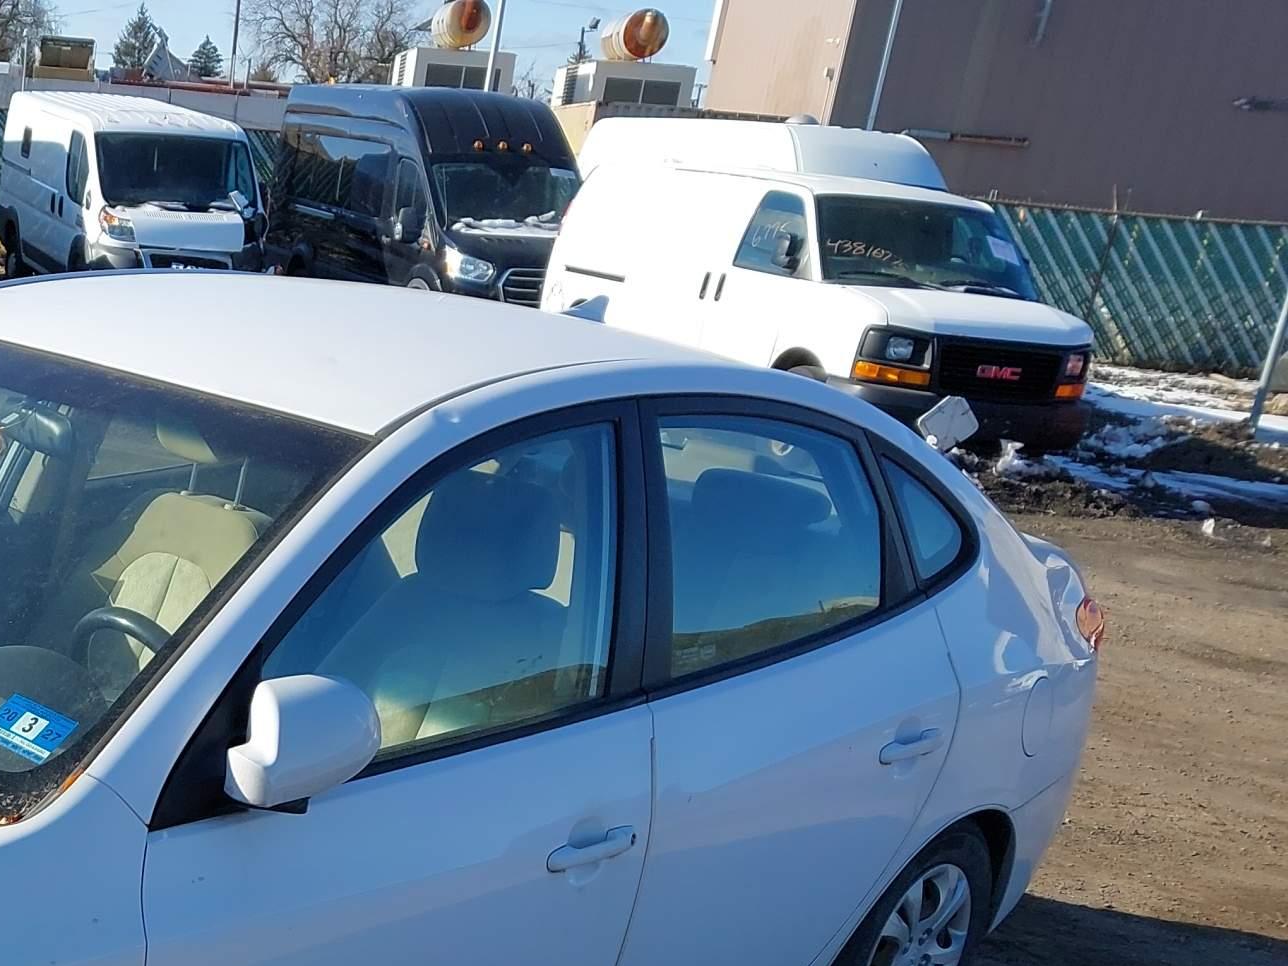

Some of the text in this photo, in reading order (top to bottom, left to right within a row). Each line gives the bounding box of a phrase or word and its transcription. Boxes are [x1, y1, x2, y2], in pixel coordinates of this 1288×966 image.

[976, 364, 1023, 378] GMC
[22, 716, 39, 734] 3
[41, 728, 62, 742] 27
